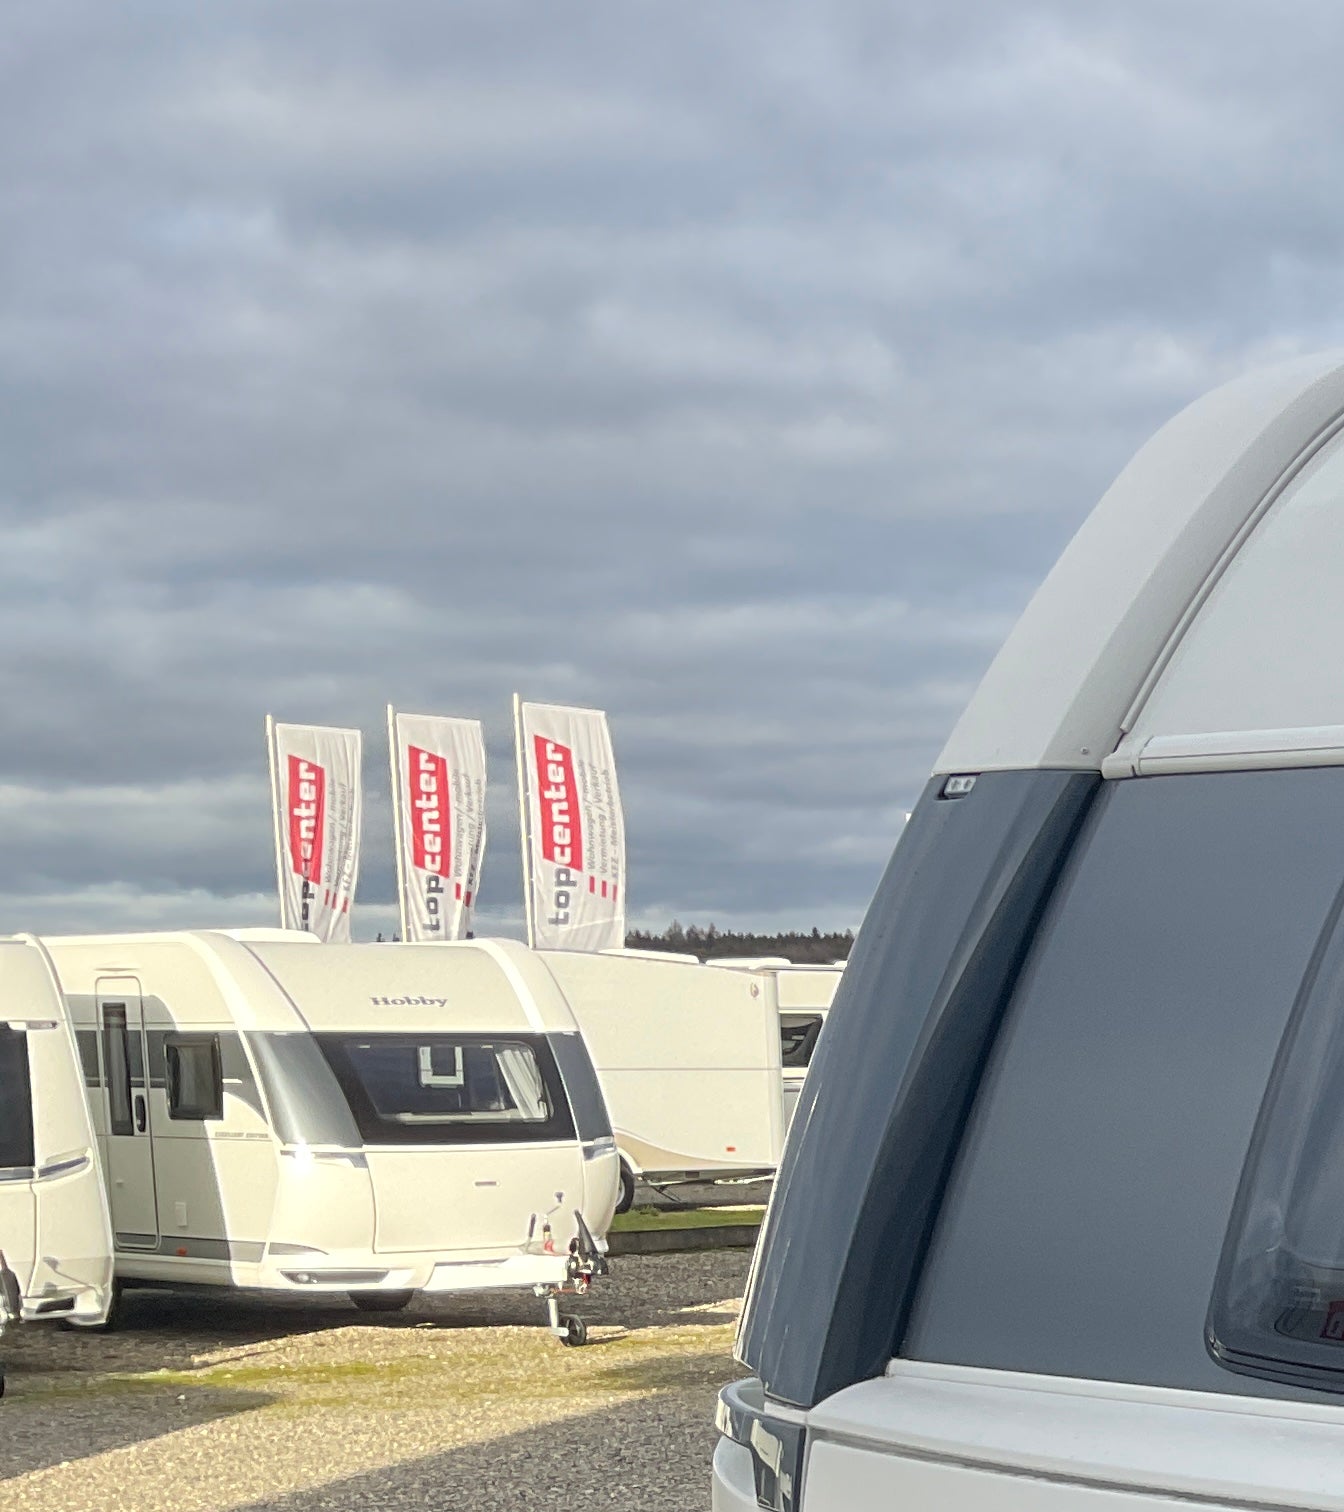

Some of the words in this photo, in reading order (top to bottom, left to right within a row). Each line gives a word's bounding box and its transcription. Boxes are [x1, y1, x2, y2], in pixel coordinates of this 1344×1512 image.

[415, 752, 444, 931] topcenter
[544, 742, 577, 926] topcenter
[369, 996, 448, 1008] Hobby
